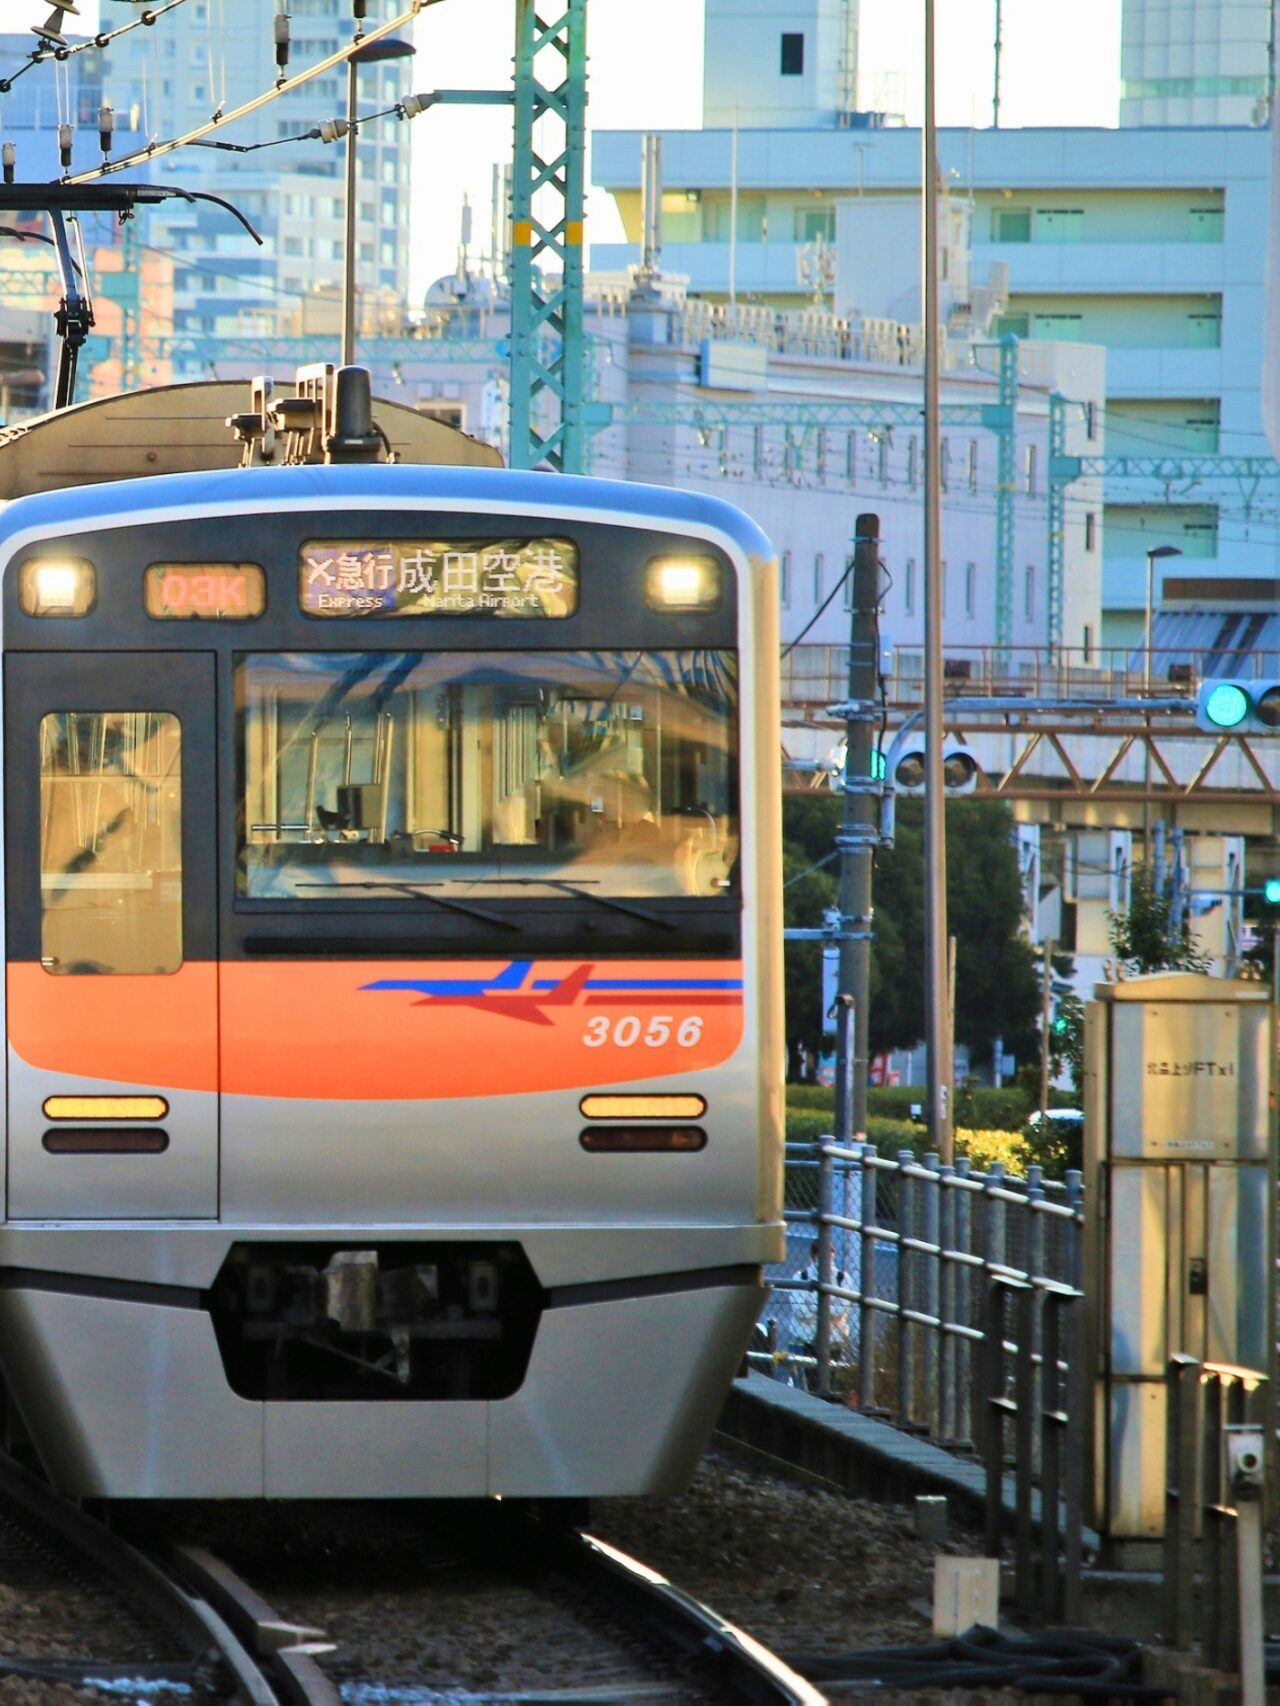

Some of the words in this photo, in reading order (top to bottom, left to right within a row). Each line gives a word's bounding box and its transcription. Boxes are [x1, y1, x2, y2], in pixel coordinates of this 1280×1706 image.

[398, 550, 562, 593] 成田空港
[163, 576, 245, 608] 03K
[319, 596, 383, 609] Express
[424, 596, 474, 609] Narita
[479, 596, 538, 609] Airport
[583, 1016, 704, 1047] 3056
